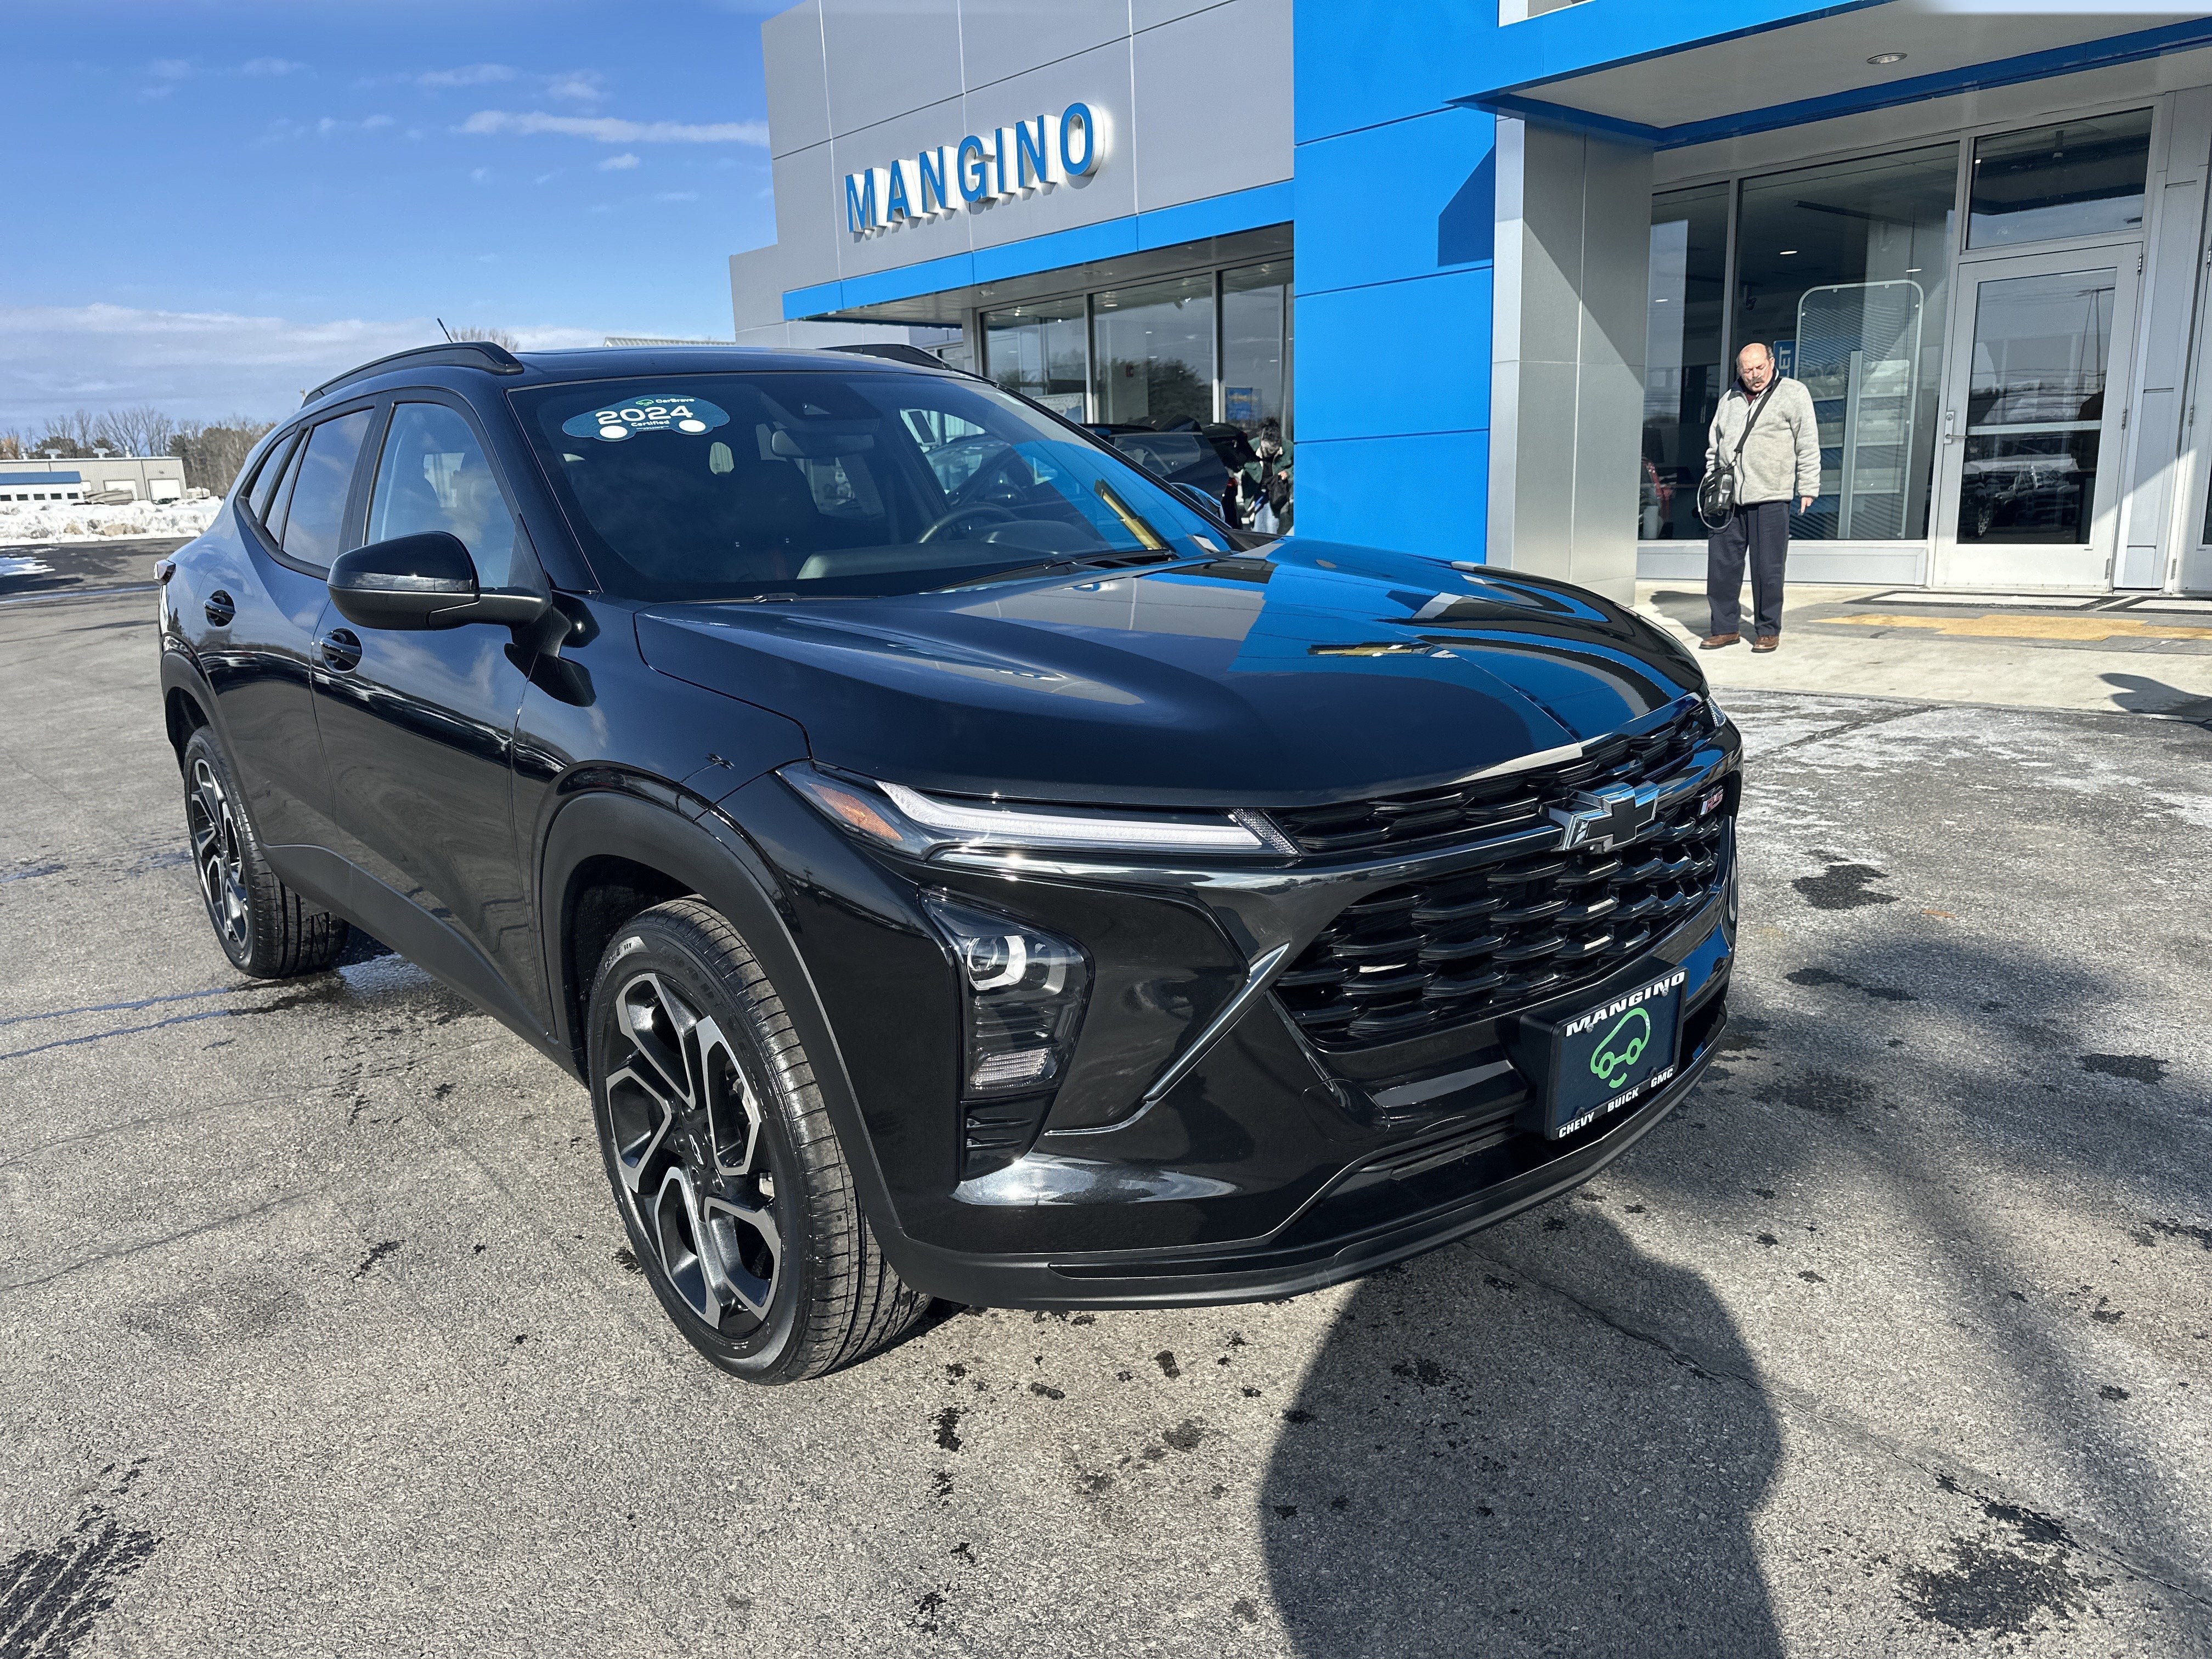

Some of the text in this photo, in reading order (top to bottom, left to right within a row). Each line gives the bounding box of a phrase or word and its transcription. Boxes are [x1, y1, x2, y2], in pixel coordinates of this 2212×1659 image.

[844, 102, 1095, 233] MANGINO
[595, 405, 693, 425] 2024
[1566, 971, 1685, 1037] MANGINO
[1559, 1068, 1673, 1138] CHEVY BUICK GMC
